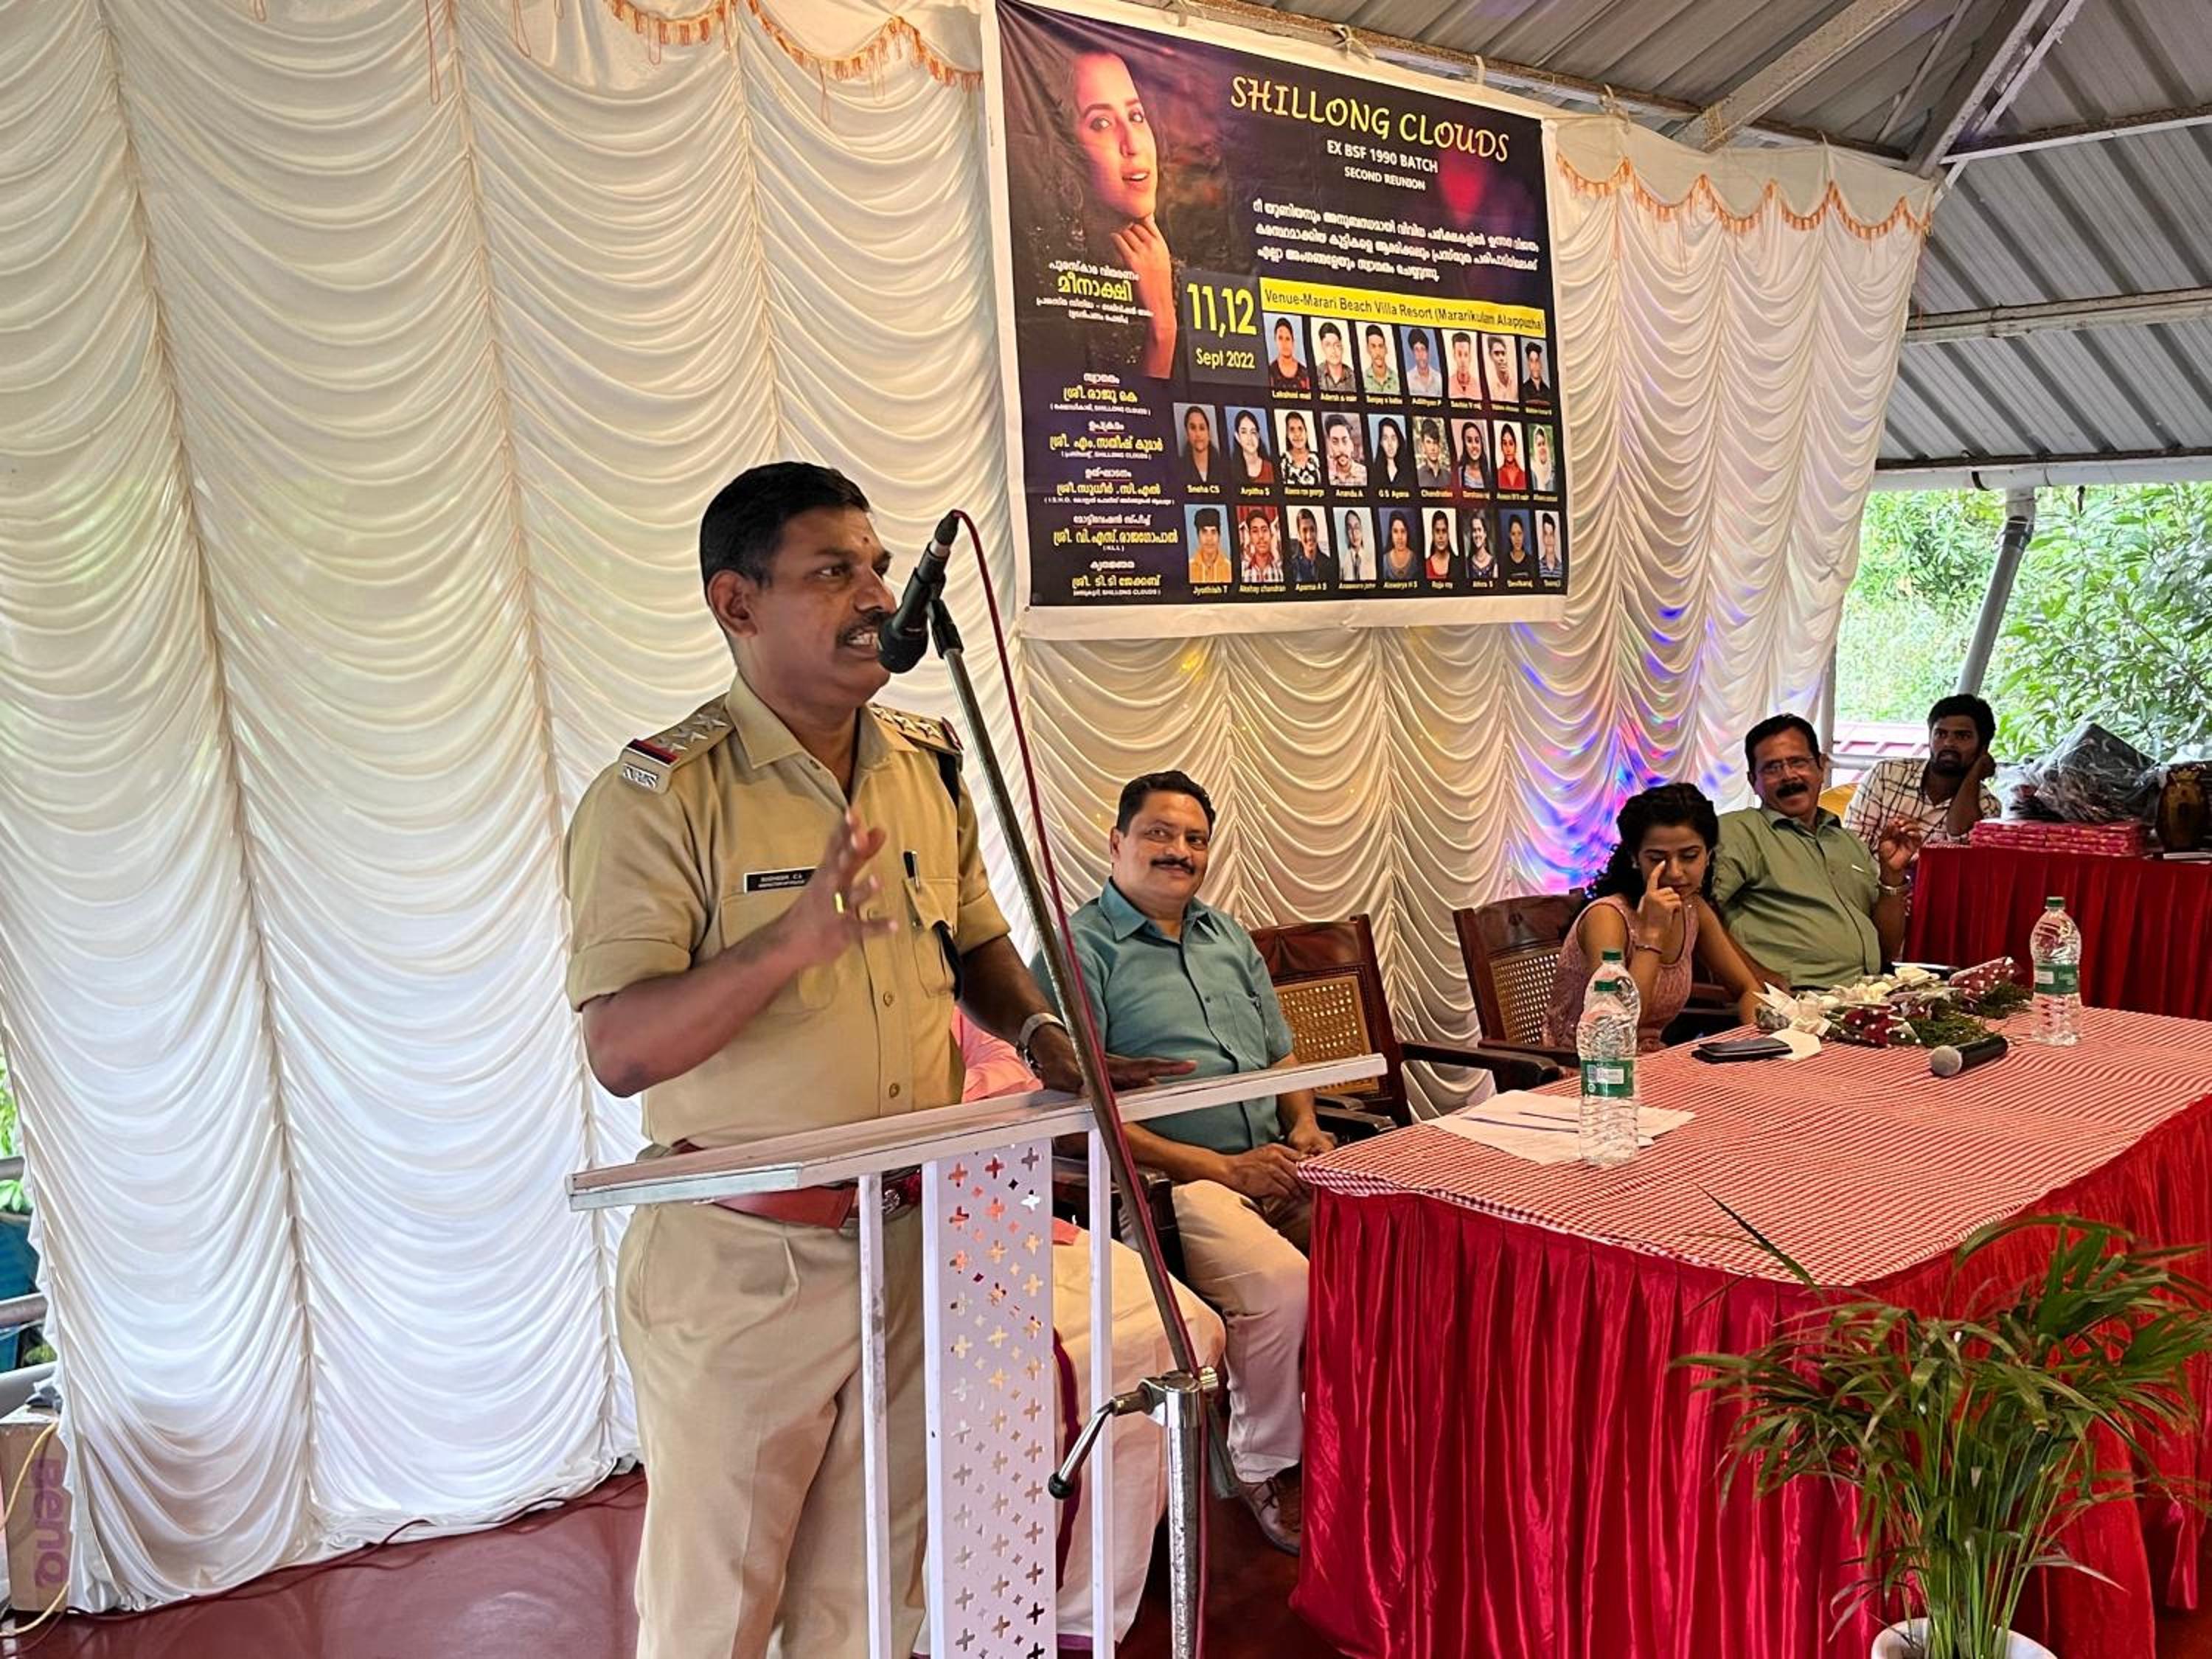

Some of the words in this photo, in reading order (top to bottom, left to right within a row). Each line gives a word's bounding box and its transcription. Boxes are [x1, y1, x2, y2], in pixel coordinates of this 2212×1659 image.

[1231, 76, 1390, 140] SHILLONG
[1399, 114, 1509, 162] CLOUDS
[1326, 139, 1342, 156] EX
[1344, 144, 1366, 159] BSF
[1370, 148, 1397, 165] 1990
[1399, 154, 1438, 173] BATCH
[1344, 166, 1382, 183] SECOND
[1384, 173, 1426, 191] REUNION
[1058, 271, 1133, 302] മീനാക്ഷി
[1187, 283, 1256, 338] 11,12
[1265, 288, 1336, 309] Venue-Marari
[1340, 298, 1371, 313] Beach
[1374, 301, 1397, 315] Villa
[1399, 305, 1433, 319] Resort
[1196, 347, 1223, 369] Sept
[1226, 350, 1255, 368] 2022
